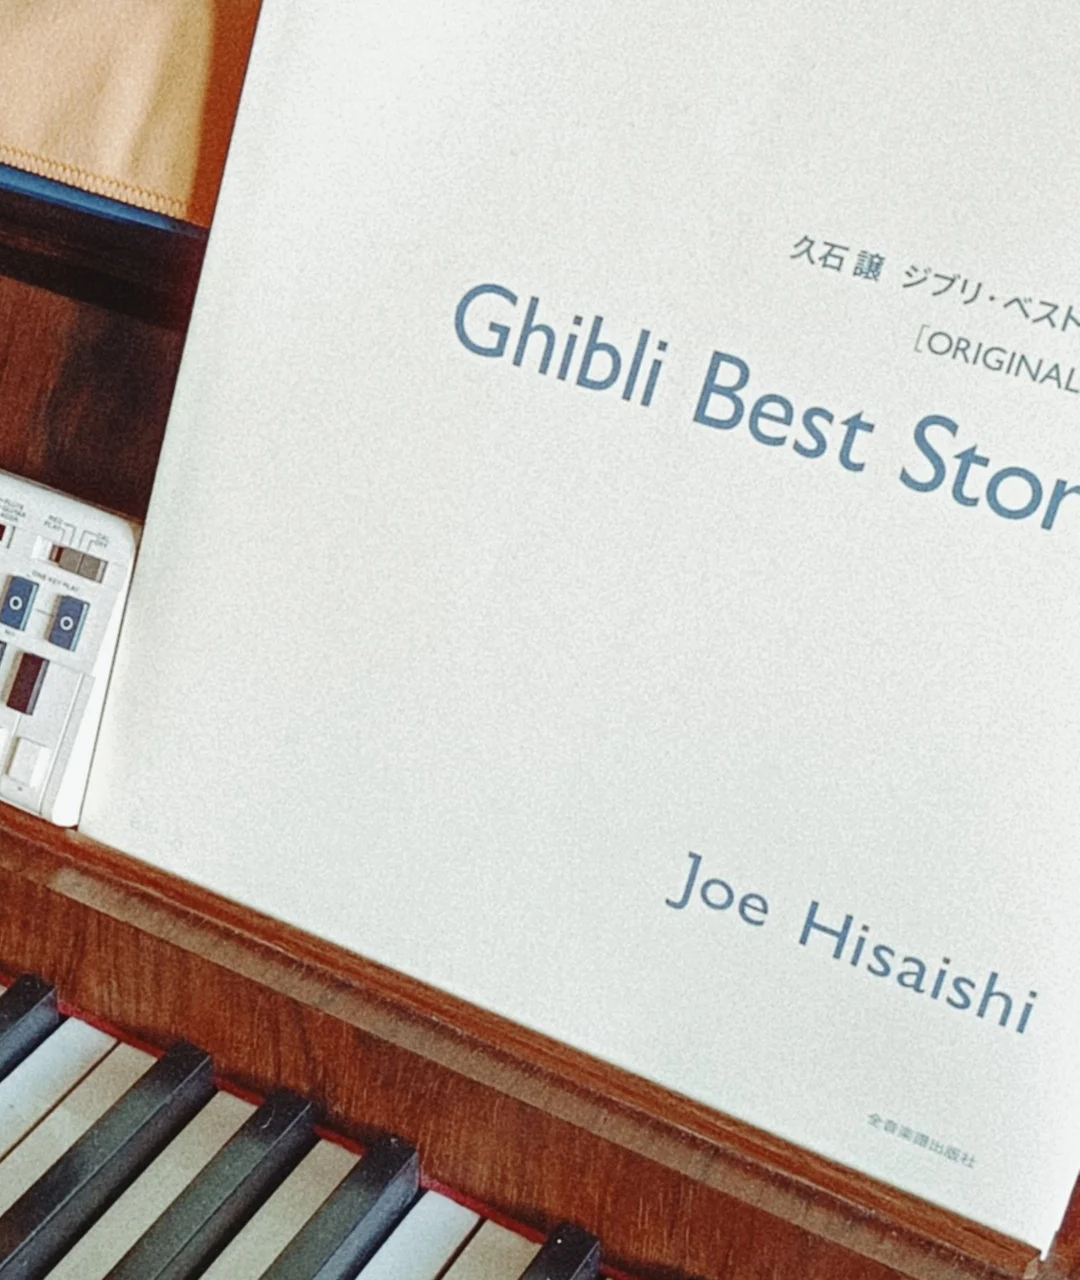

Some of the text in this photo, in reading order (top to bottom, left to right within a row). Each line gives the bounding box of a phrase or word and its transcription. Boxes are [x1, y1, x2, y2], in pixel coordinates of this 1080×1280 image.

[454, 283, 1080, 531] Ghibli Best Stor
[665, 851, 1038, 1034] Joe Hisaishi
